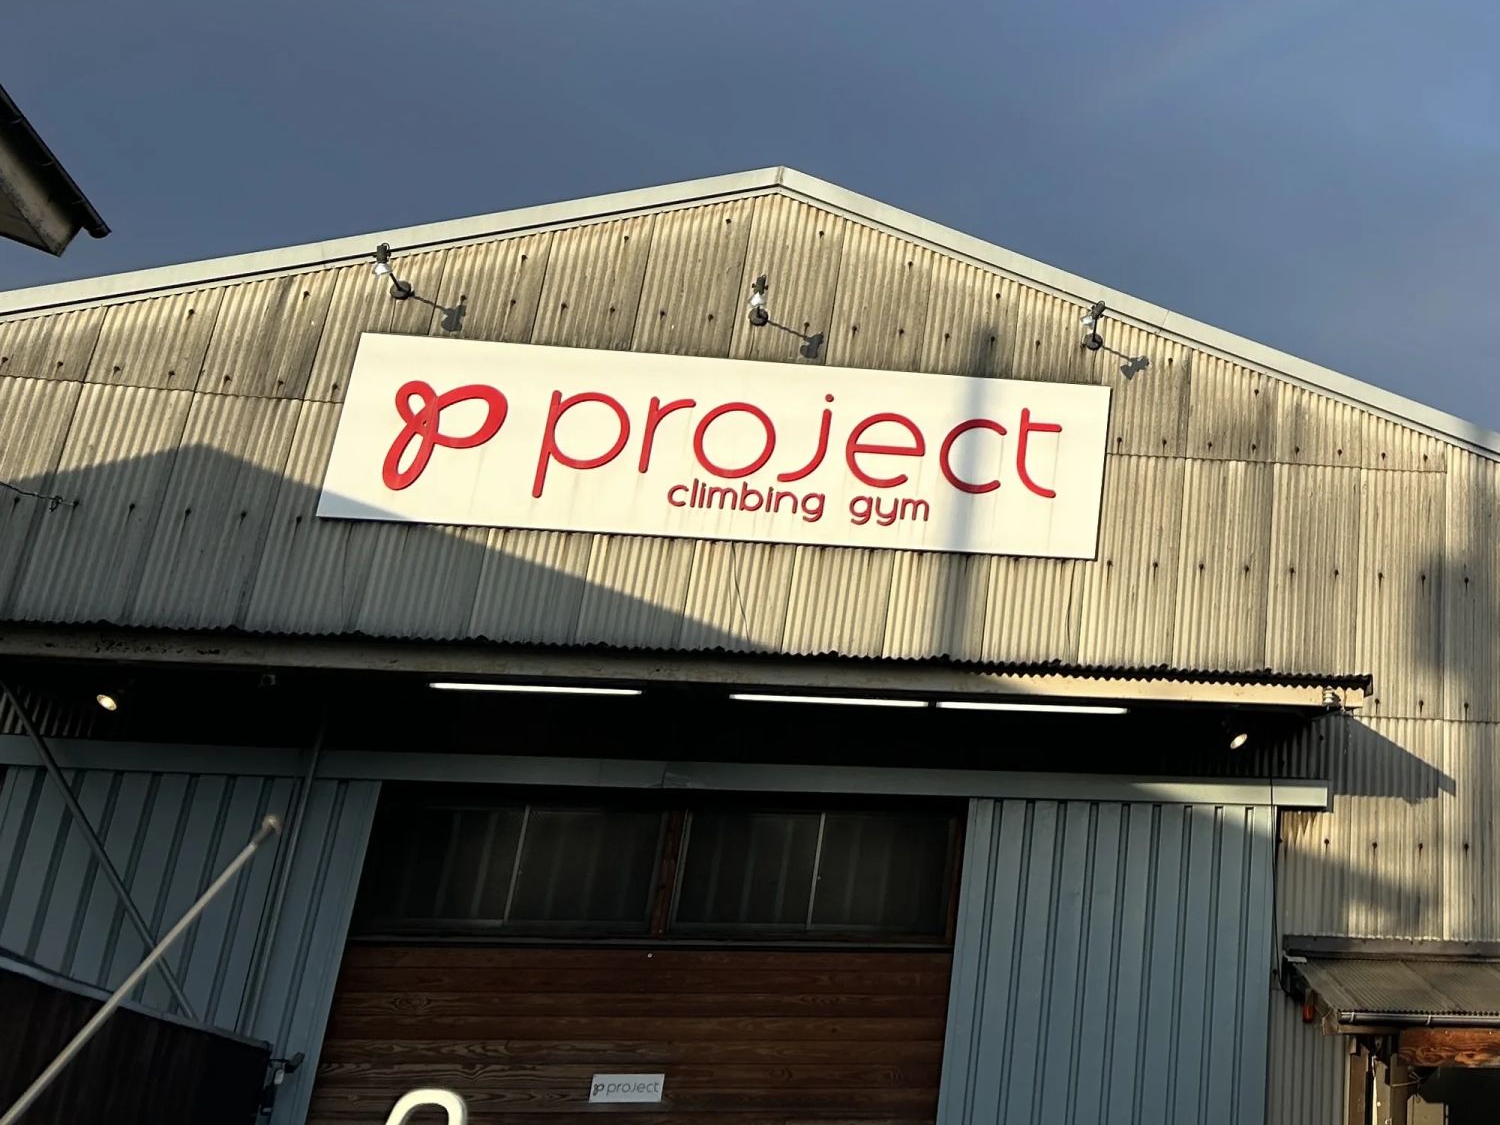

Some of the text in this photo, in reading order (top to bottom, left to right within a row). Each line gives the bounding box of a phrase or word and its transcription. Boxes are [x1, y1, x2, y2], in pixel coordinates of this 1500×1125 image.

[531, 389, 1063, 500] project
[667, 480, 930, 527] climbing gym
[606, 1081, 660, 1096] project
